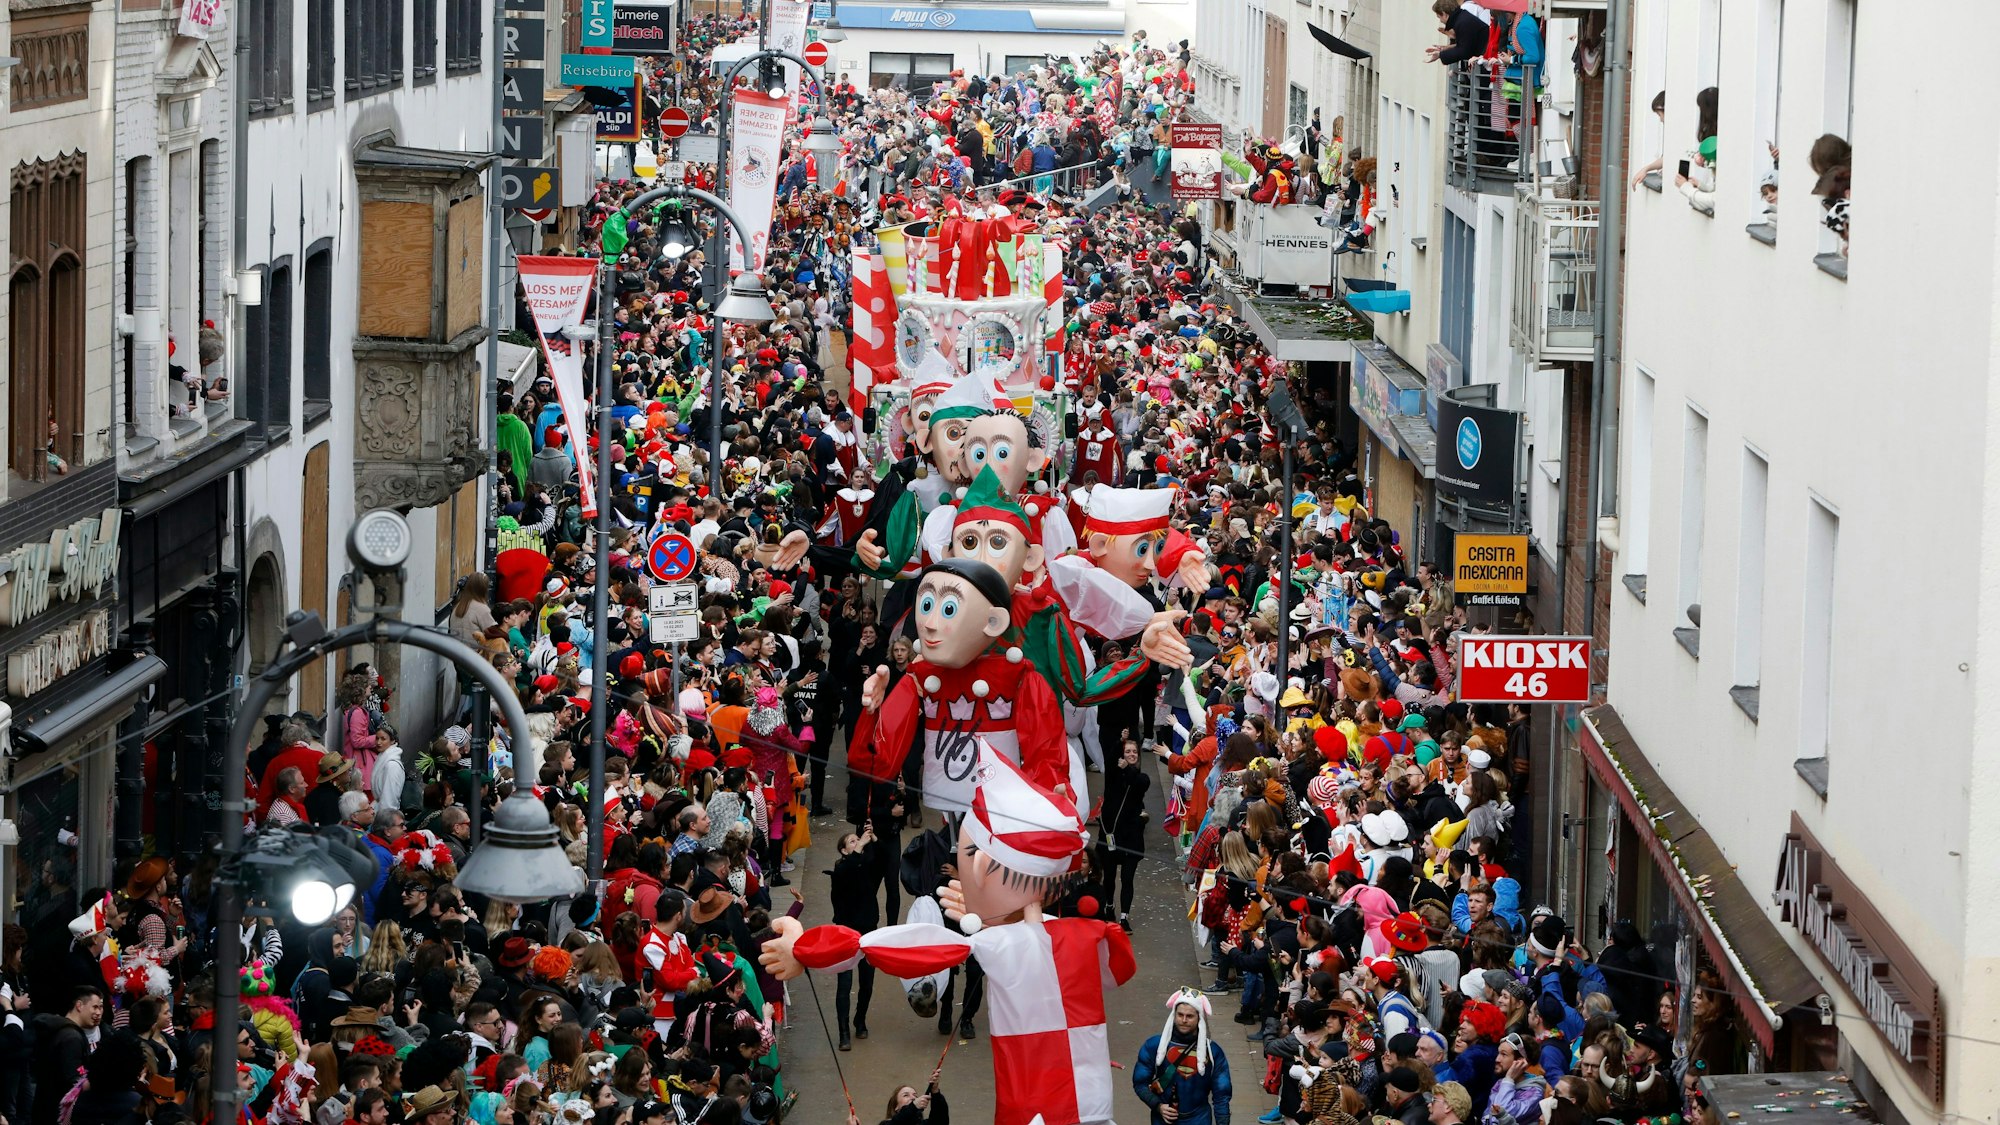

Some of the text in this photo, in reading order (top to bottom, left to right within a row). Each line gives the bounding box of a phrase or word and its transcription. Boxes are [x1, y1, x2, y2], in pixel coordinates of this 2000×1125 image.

[613, 9, 659, 20] fümerie
[890, 9, 928, 22] APOLLO
[563, 63, 632, 78] Reisebüro
[596, 111, 632, 124] ALDI
[1265, 239, 1328, 248] HENNES
[527, 284, 556, 295] LOSS
[1468, 547, 1515, 561] CASITA
[1459, 565, 1523, 580] MEXICANA
[1472, 595, 1520, 605] Gaffel Kölsch
[1464, 642, 1588, 669] KIOSK
[1504, 672, 1548, 698] 46
